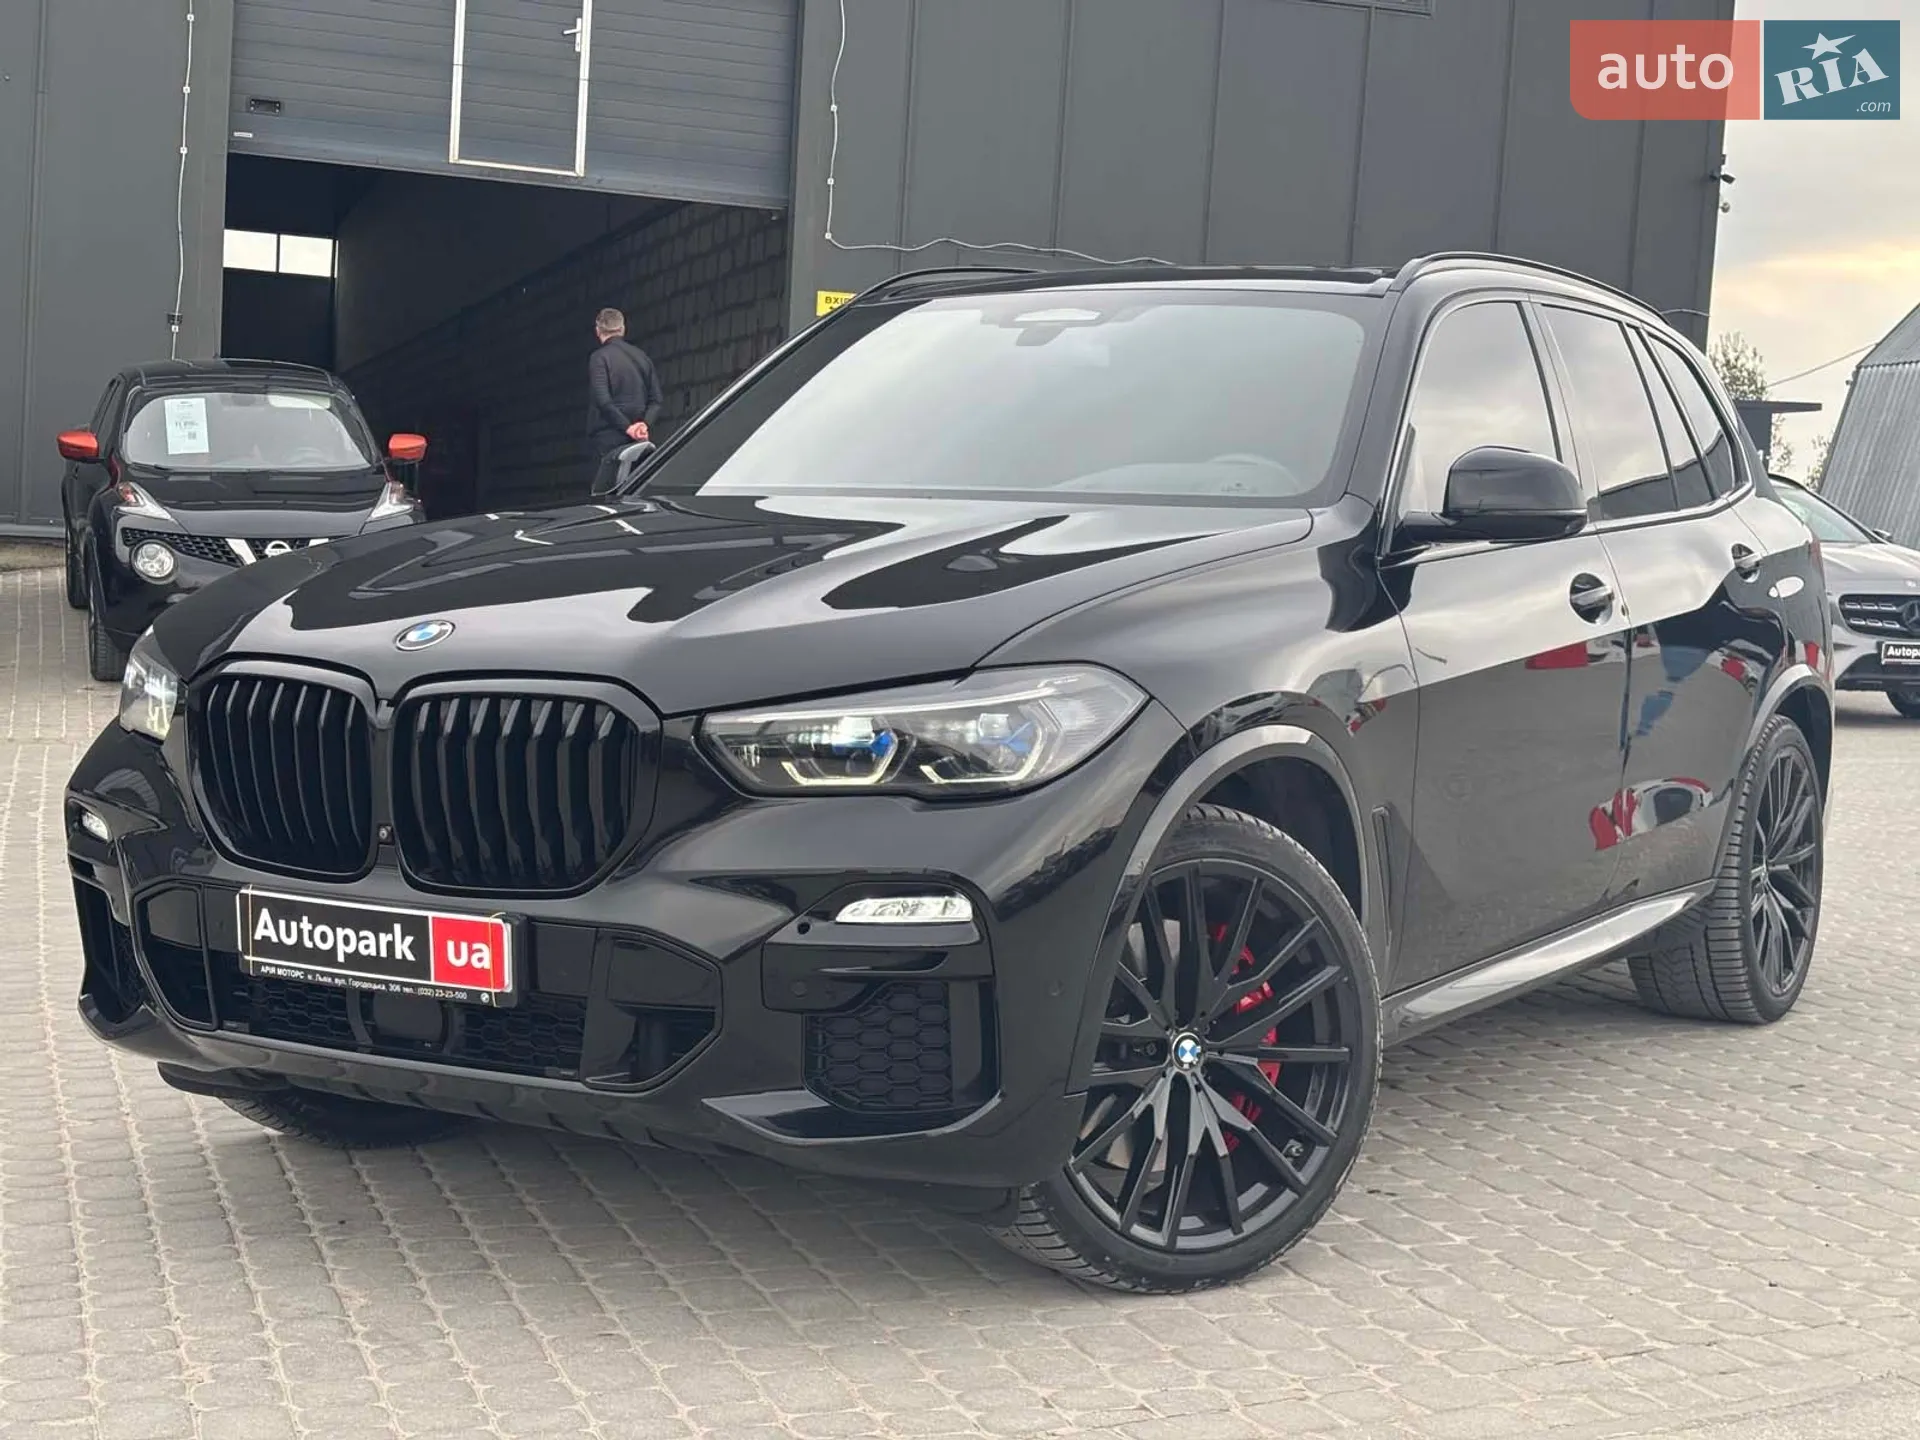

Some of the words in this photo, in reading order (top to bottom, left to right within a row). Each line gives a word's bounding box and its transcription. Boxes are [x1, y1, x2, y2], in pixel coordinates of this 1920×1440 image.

[254, 907, 416, 963] Autopark
[446, 938, 491, 970] ua
[277, 967, 305, 980] МОТОРС
